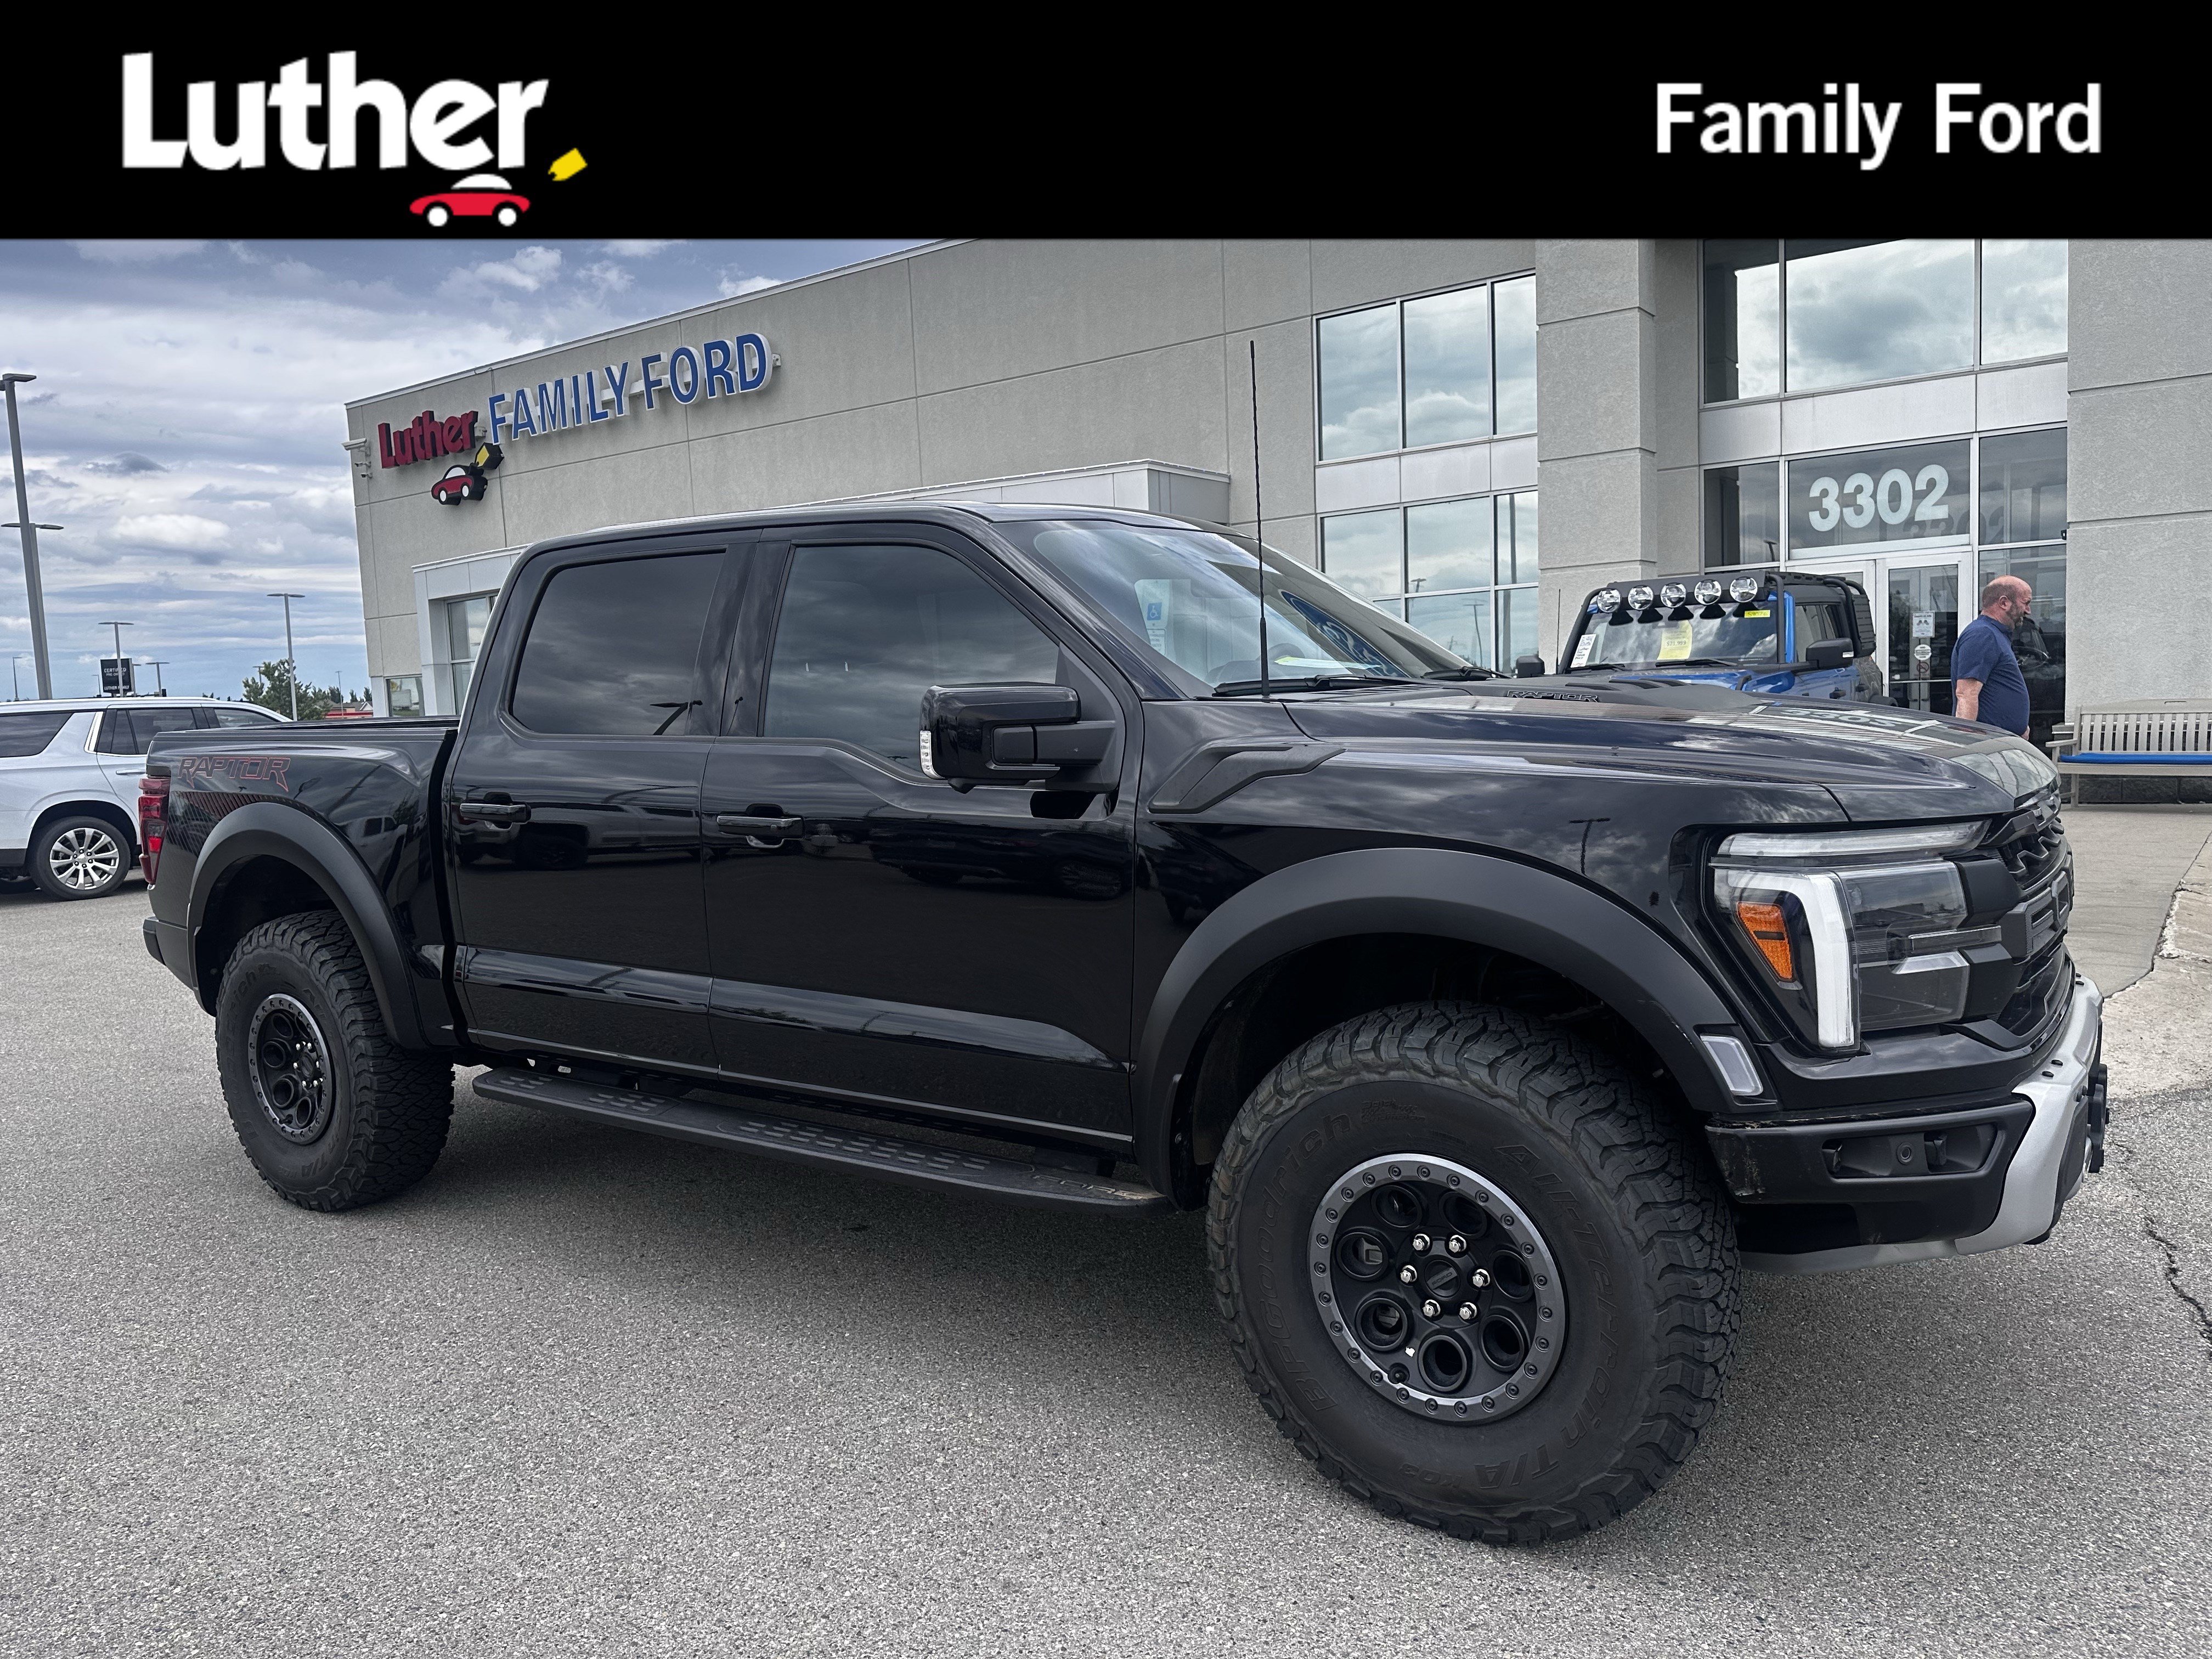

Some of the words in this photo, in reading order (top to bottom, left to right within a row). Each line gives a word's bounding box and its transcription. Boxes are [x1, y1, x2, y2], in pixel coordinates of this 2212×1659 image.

[488, 360, 629, 445] FAMILY
[641, 333, 772, 410] FORD
[377, 410, 478, 469] Luther
[1808, 464, 1949, 532] 3302
[1506, 690, 1599, 703] RAPTOR
[177, 757, 291, 792] RAPTOR
